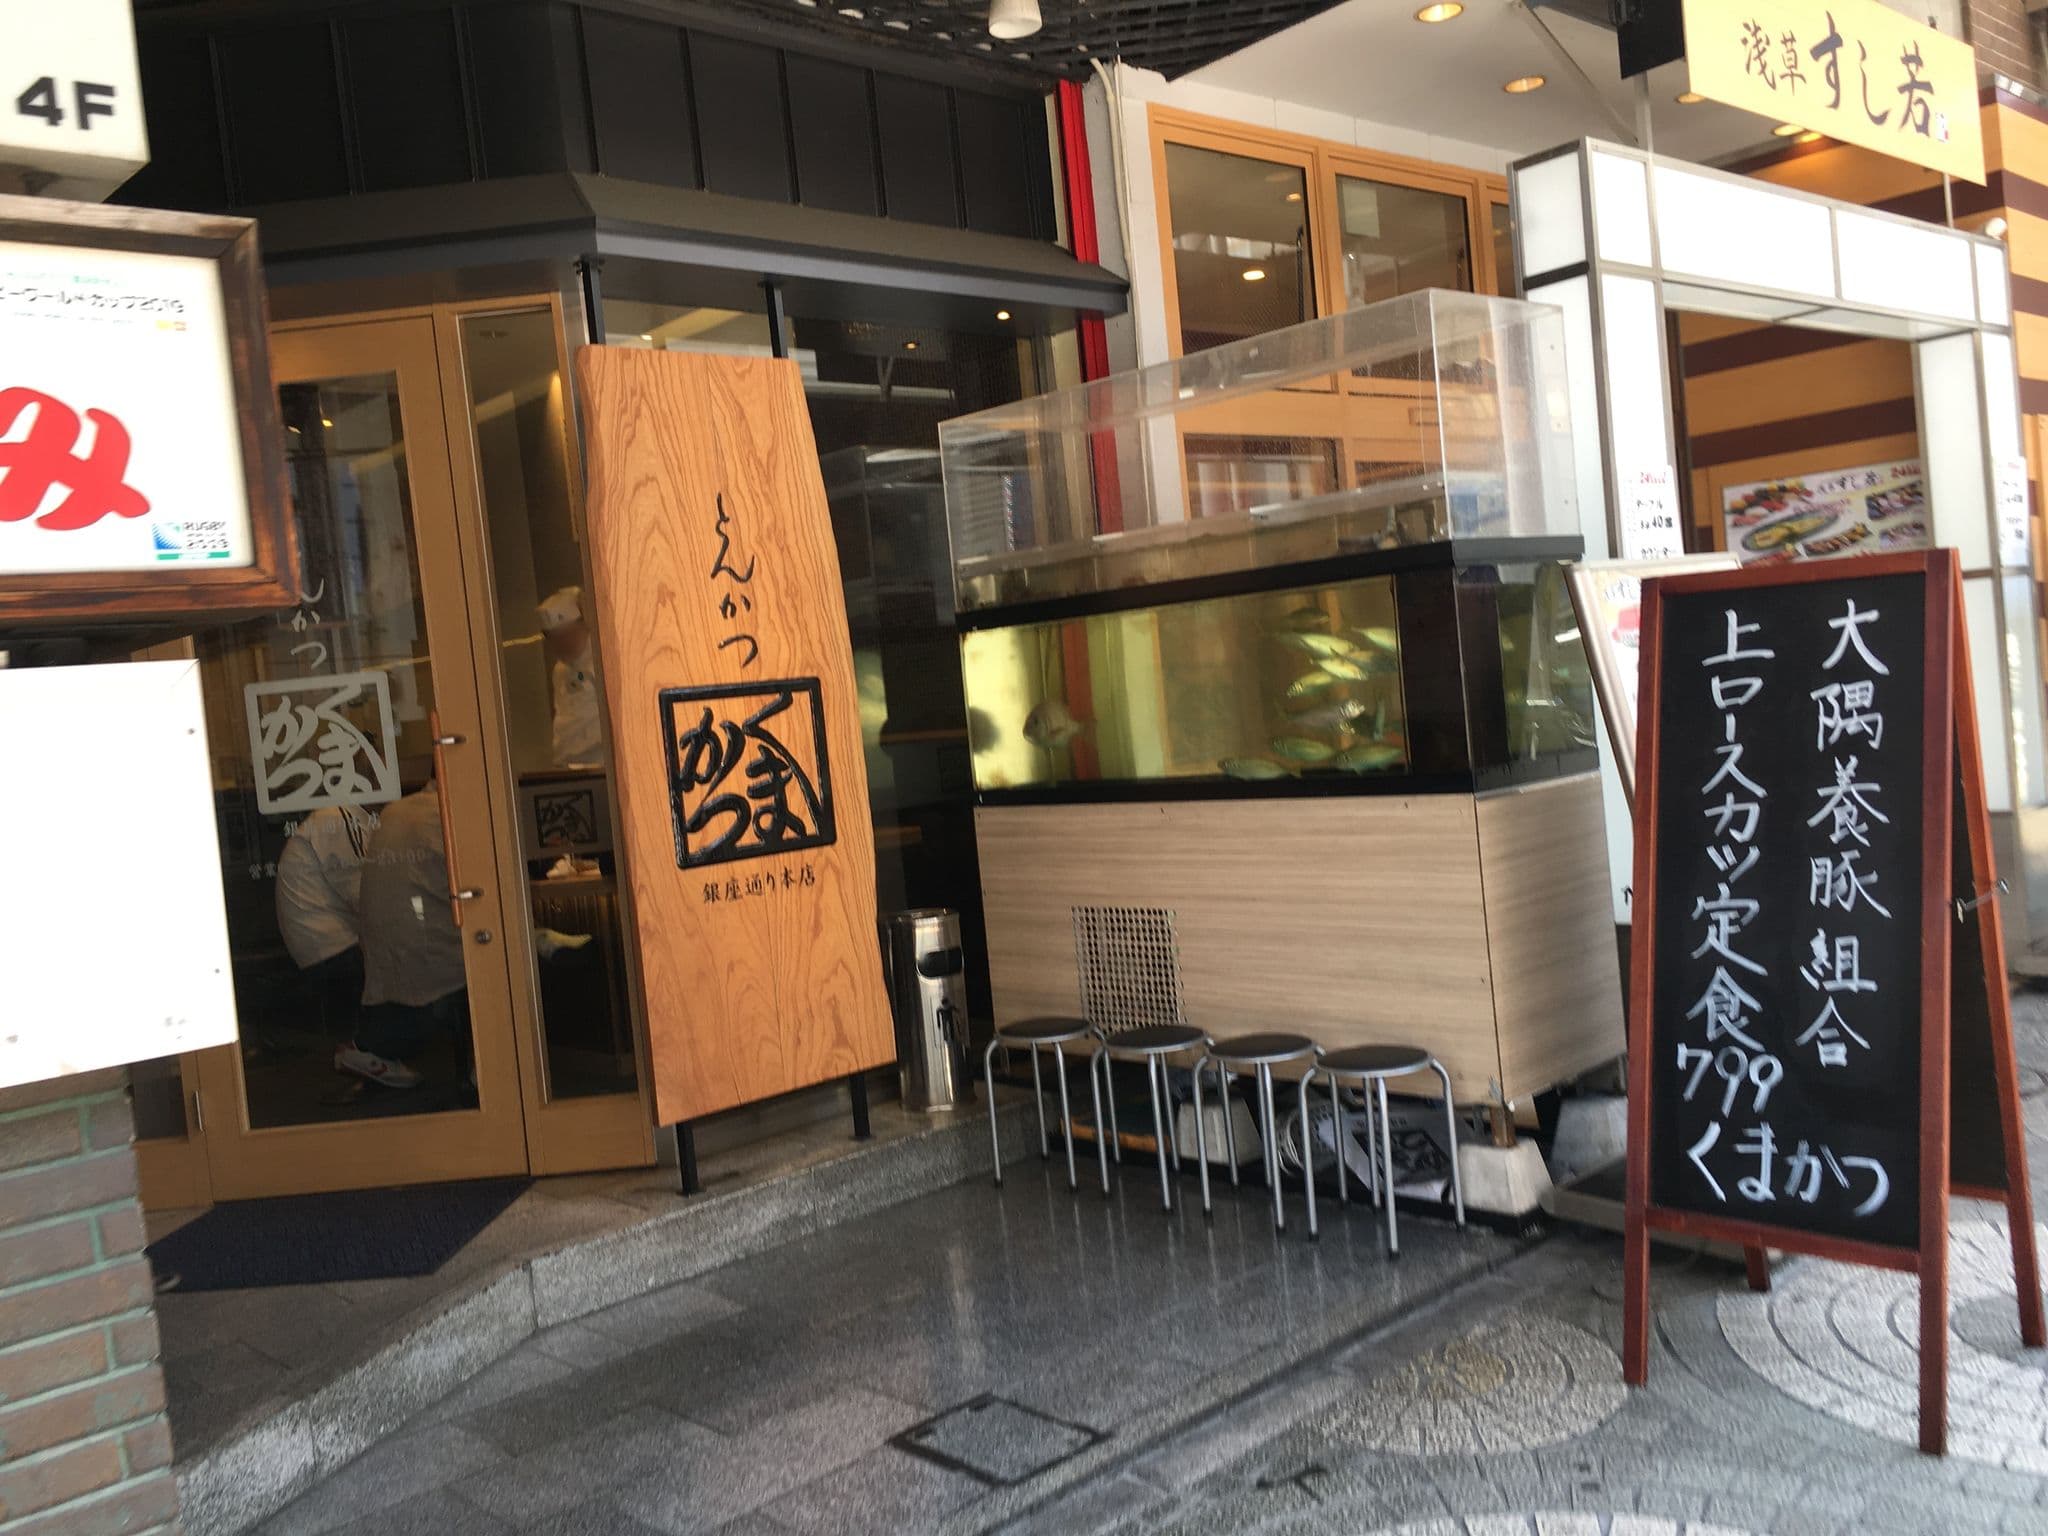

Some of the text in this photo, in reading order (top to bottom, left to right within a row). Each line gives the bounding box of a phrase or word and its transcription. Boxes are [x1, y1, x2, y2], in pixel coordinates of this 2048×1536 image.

[15, 76, 115, 130] 4F
[711, 492, 758, 667] とんかつ
[703, 864, 815, 903] 銀座通り本店
[1677, 1043, 1784, 1118] 799
[1686, 1120, 1889, 1218] くまかつ
